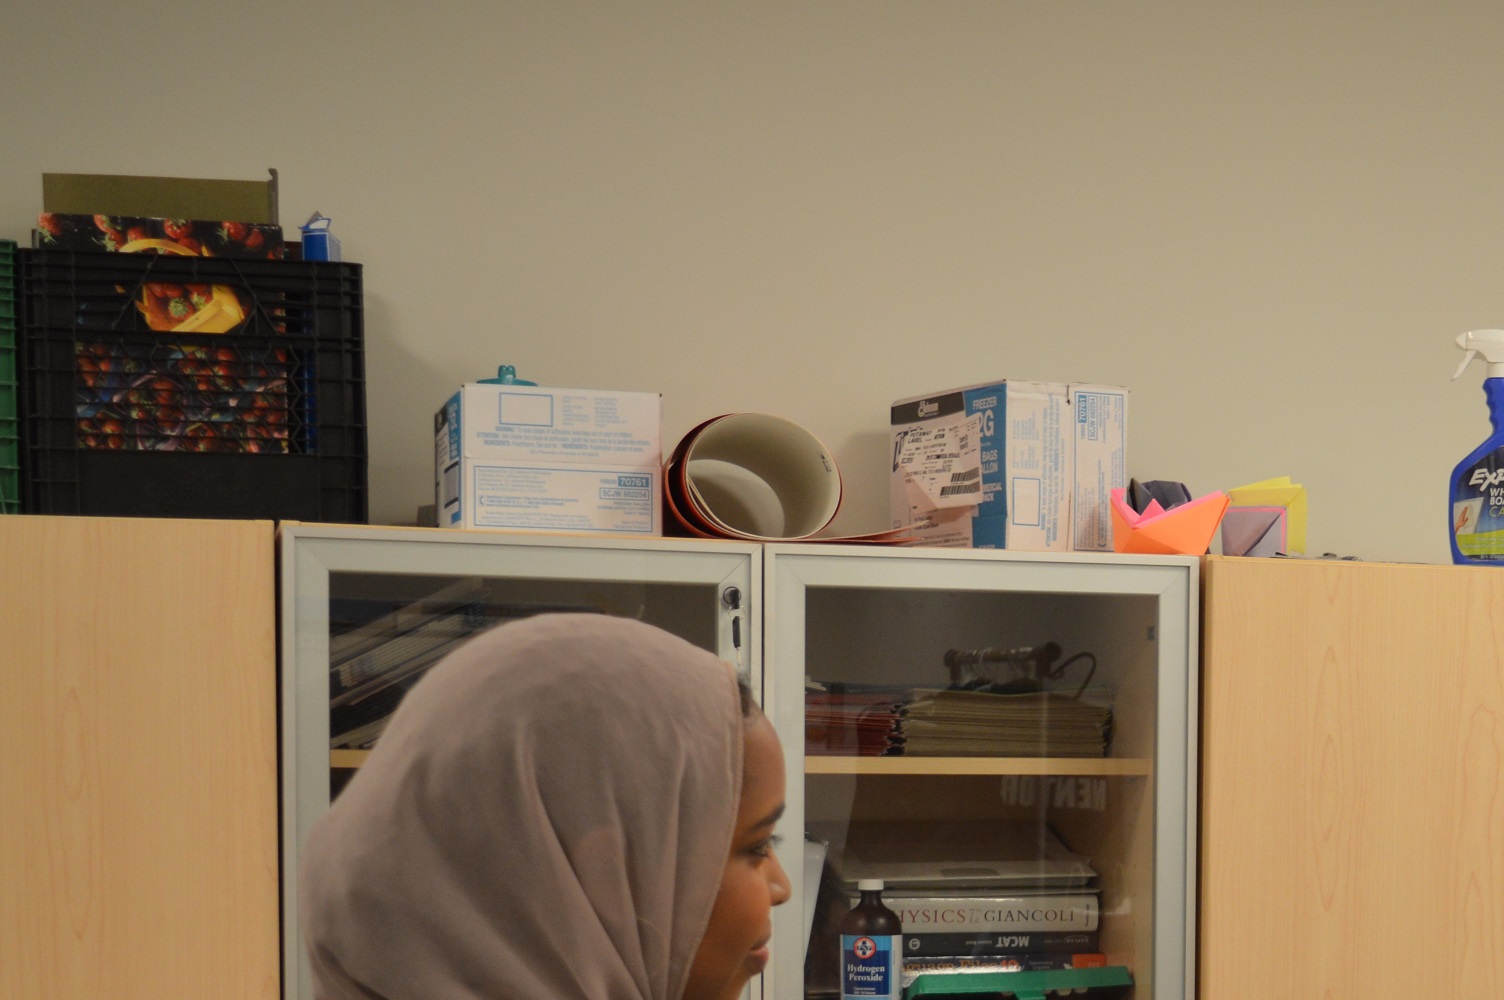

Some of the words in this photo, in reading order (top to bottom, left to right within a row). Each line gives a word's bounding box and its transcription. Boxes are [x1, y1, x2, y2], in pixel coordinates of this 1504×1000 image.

[972, 396, 998, 410] FREEZER
[982, 450, 998, 462] BAGS
[619, 477, 647, 487] 70761
[899, 909, 966, 924] HYSICS
[984, 909, 1075, 923] GIANCOLI
[996, 936, 1030, 948] MCAT
[847, 963, 886, 974] Hydrogen
[848, 973, 884, 982] Peroxide
